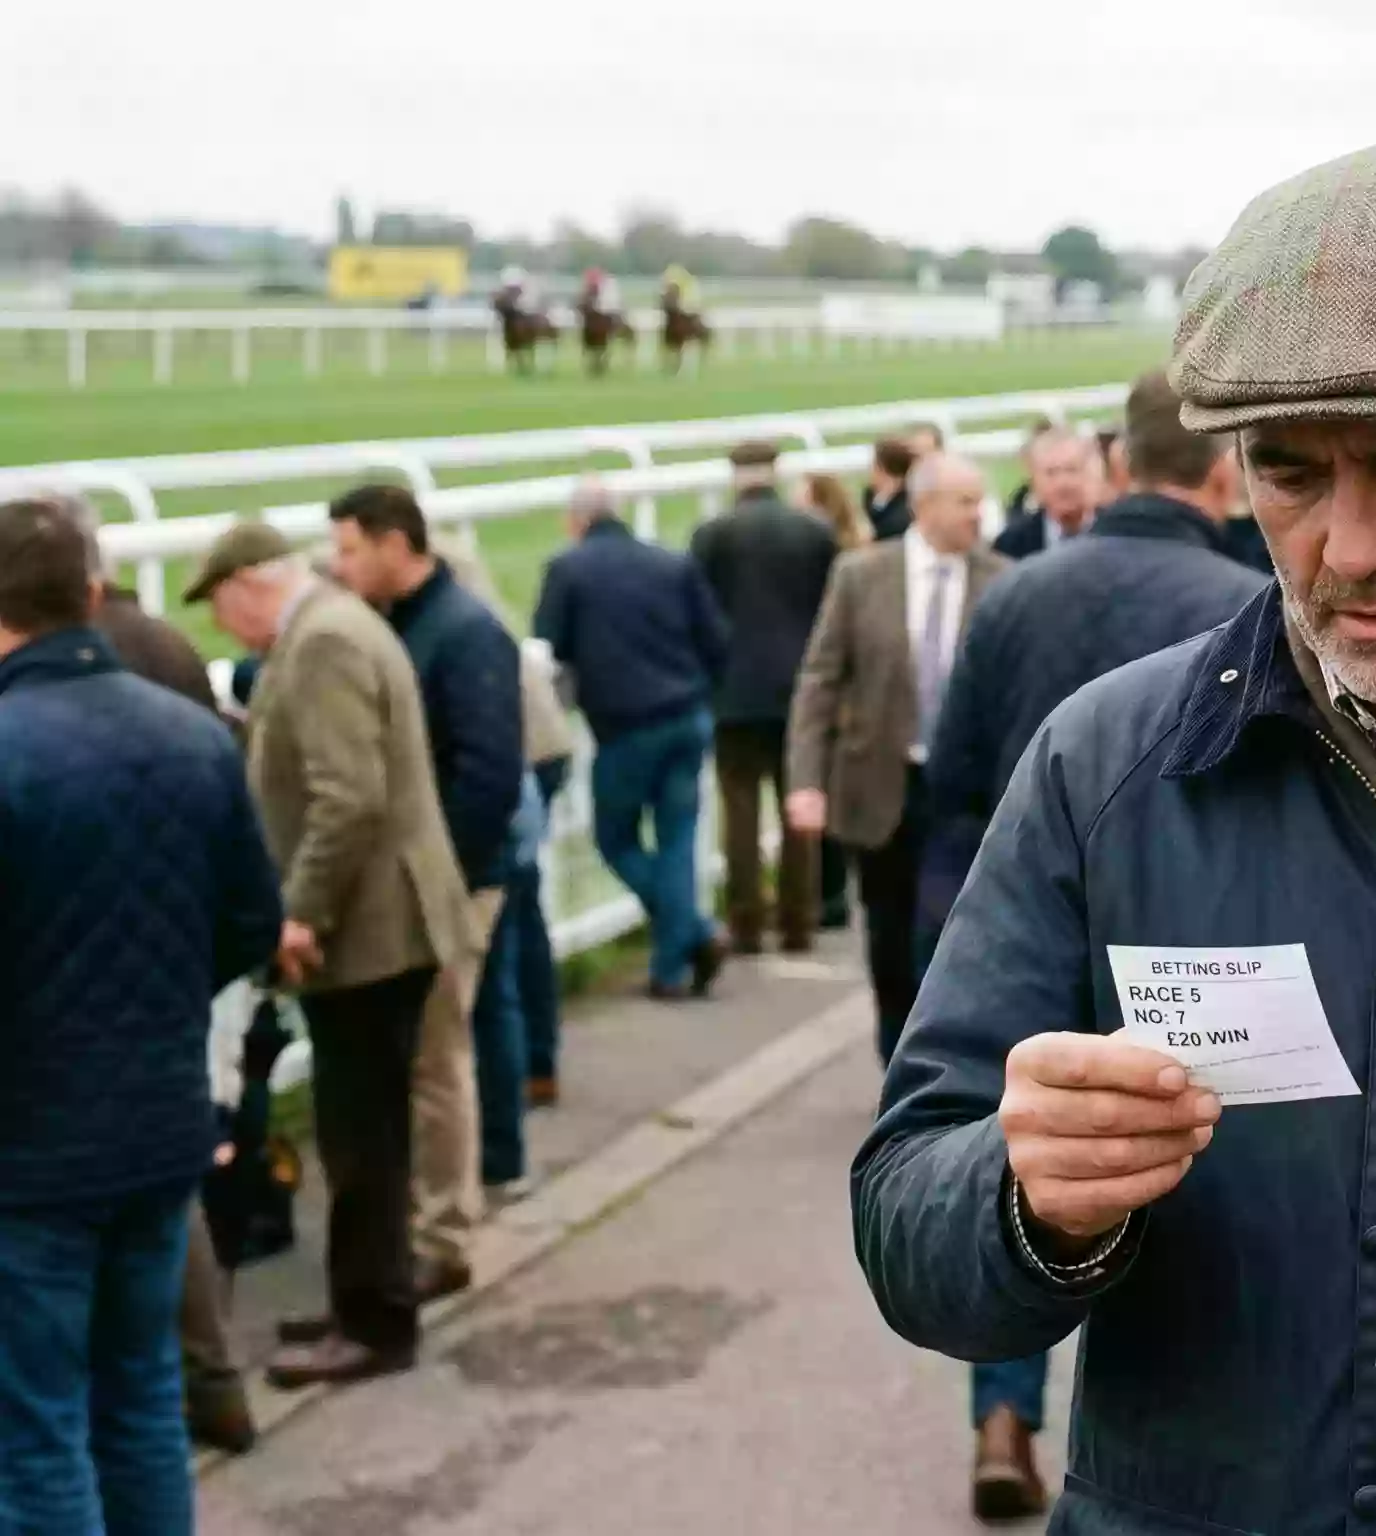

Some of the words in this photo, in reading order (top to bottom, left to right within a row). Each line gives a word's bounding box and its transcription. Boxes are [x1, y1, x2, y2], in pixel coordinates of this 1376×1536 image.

[1151, 961, 1221, 976] BETTING
[1226, 961, 1262, 975] SLIP
[1129, 986, 1185, 1003] RACE
[1190, 987, 1201, 1003] 5
[1134, 1008, 1170, 1025] NO:
[1175, 1010, 1185, 1025] 7
[1167, 1030, 1201, 1047] £20
[1206, 1028, 1250, 1045] WIN
